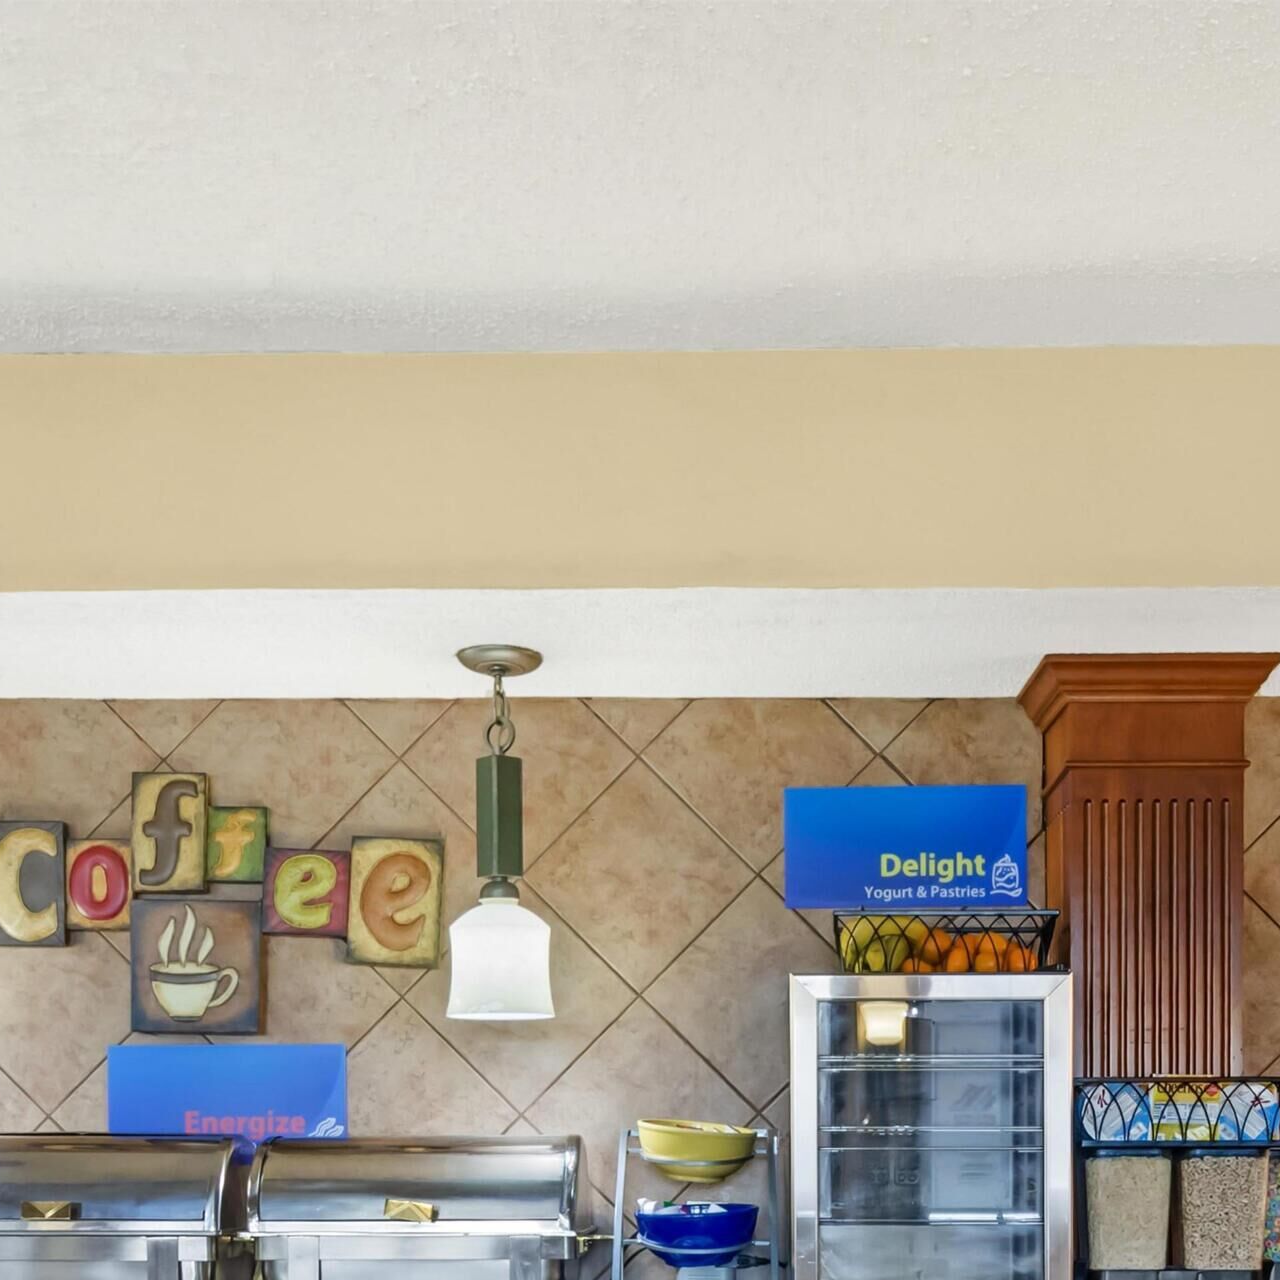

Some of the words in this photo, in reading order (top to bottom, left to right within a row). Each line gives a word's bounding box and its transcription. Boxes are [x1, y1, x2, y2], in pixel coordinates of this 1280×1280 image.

[880, 852, 986, 883] Delight
[864, 886, 913, 902] Yogurt
[916, 886, 927, 898] &
[930, 885, 986, 898] Pastries
[184, 1109, 306, 1140] Energize
